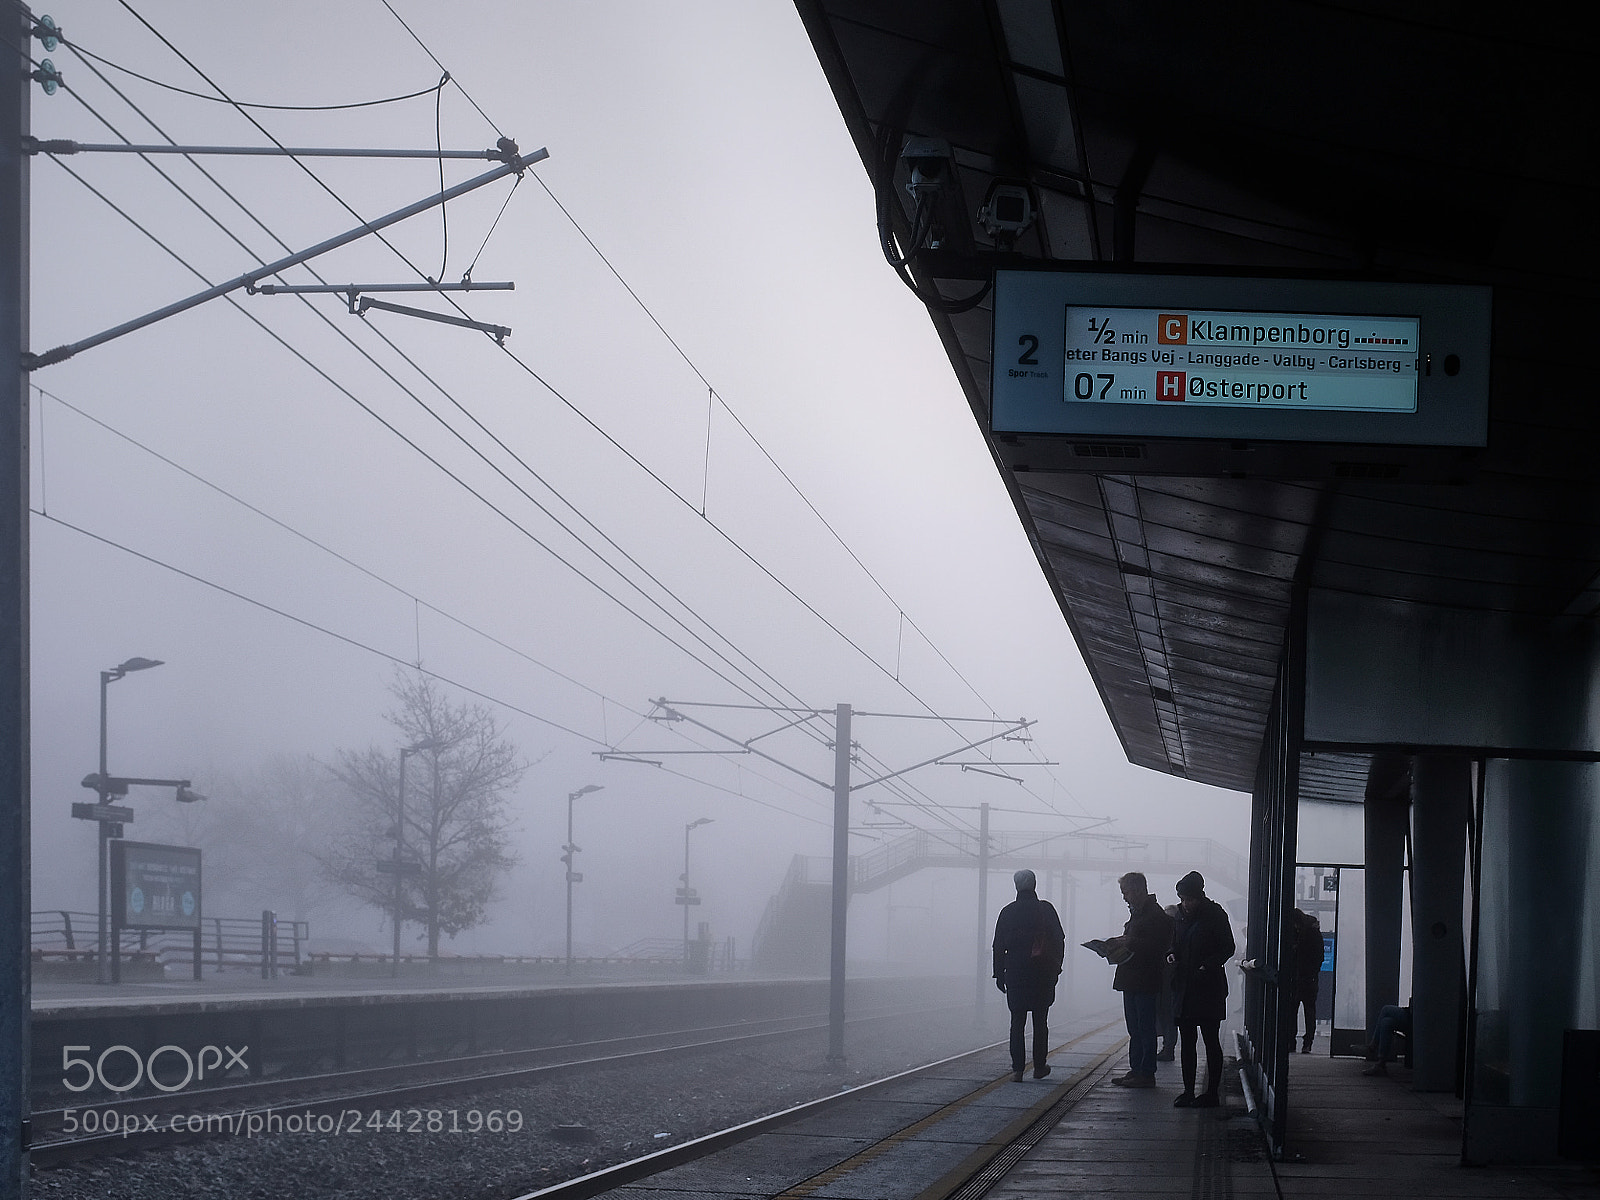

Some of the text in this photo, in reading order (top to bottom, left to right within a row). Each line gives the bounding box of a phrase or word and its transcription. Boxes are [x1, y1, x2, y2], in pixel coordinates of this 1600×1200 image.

[1121, 330, 1148, 344] min
[1165, 319, 1181, 340] C
[1191, 320, 1350, 348] Klampenborg
[1018, 334, 1039, 365] 2
[1101, 349, 1147, 364] Bangs
[1151, 350, 1175, 365] Vej
[1188, 351, 1260, 368] Langgade
[1273, 354, 1315, 370] Valby
[1328, 356, 1401, 372] Carlsberg
[1008, 368, 1028, 378] Spor
[1074, 372, 1308, 402] 07 min H Østerport
[1327, 880, 1334, 889] 2
